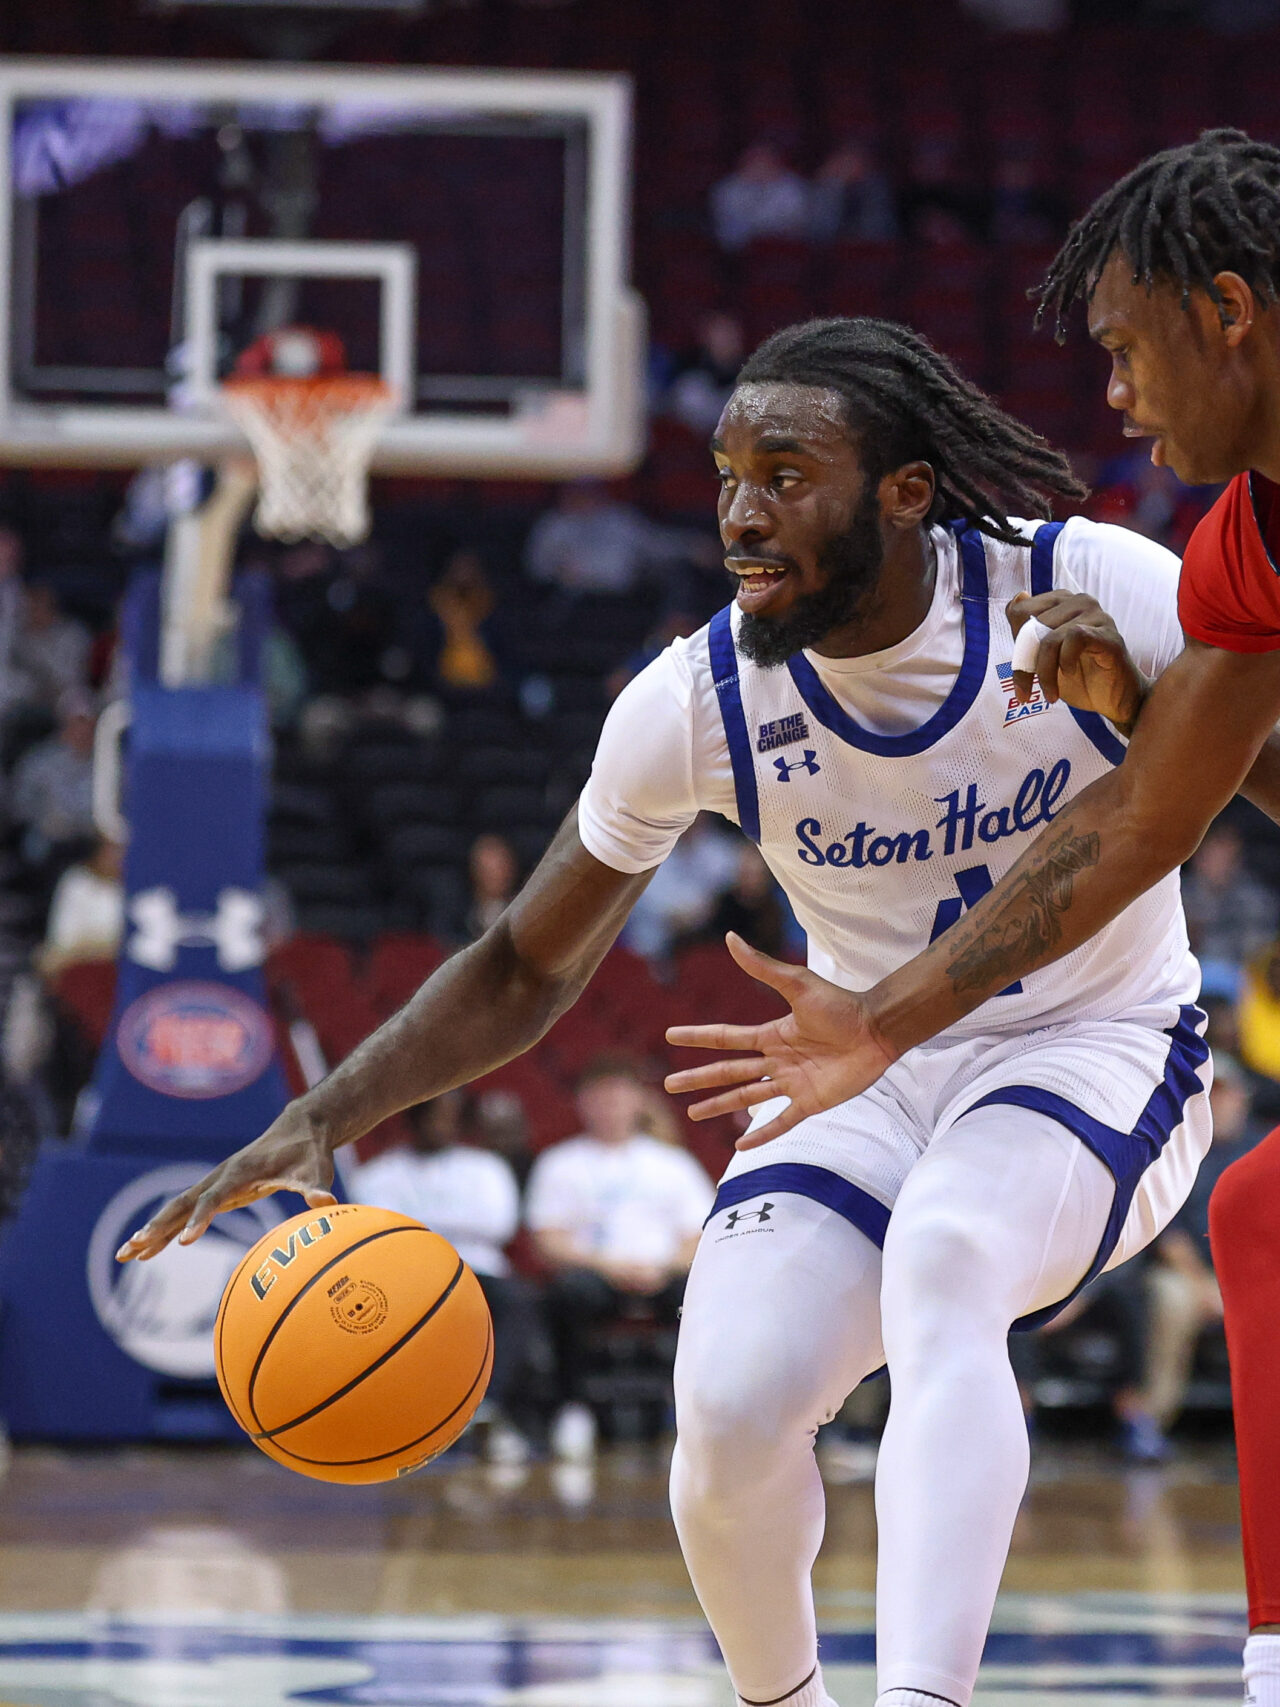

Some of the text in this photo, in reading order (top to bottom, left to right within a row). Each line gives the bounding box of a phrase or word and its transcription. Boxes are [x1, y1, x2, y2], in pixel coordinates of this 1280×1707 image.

[1005, 701, 1050, 721] EAST
[1008, 690, 1041, 710] BG
[760, 713, 804, 738] BE THE
[758, 725, 809, 753] CHANGE
[795, 758, 1072, 869] Seton Hall
[250, 1215, 333, 1302] EVO
